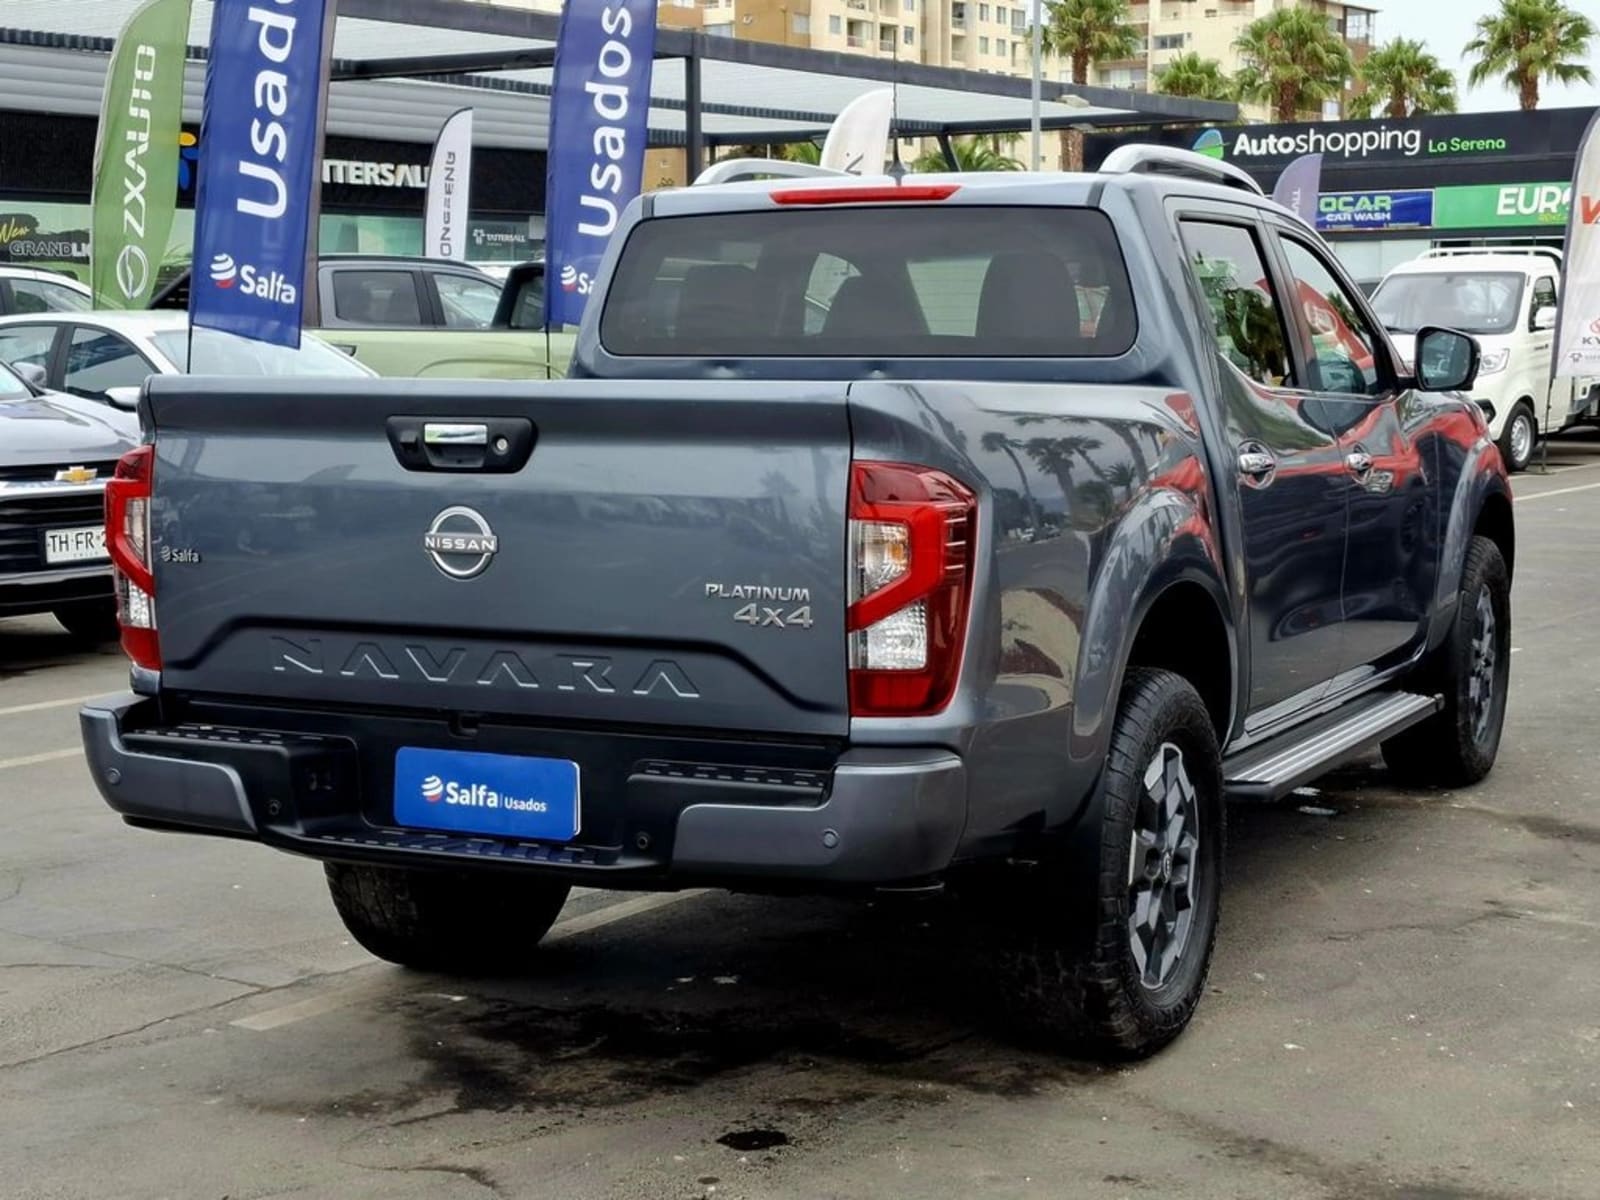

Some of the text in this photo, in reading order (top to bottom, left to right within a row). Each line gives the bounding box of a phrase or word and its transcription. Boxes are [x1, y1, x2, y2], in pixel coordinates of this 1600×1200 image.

[237, 0, 297, 219] Usad
[578, 6, 632, 237] Usados
[123, 44, 155, 238] ZXAUTO
[1232, 126, 1506, 158] Autoshopping La Serena
[322, 159, 430, 188] TTERSAL
[1325, 211, 1391, 222] CAR WASH
[240, 264, 296, 304] Salfa
[172, 549, 200, 563] Salfa
[425, 537, 496, 551] NISSAN
[705, 583, 811, 602] PLATINUM
[733, 603, 814, 629] 4x4
[270, 636, 700, 699] NAVARA
[446, 782, 547, 813] Salfa Usados
